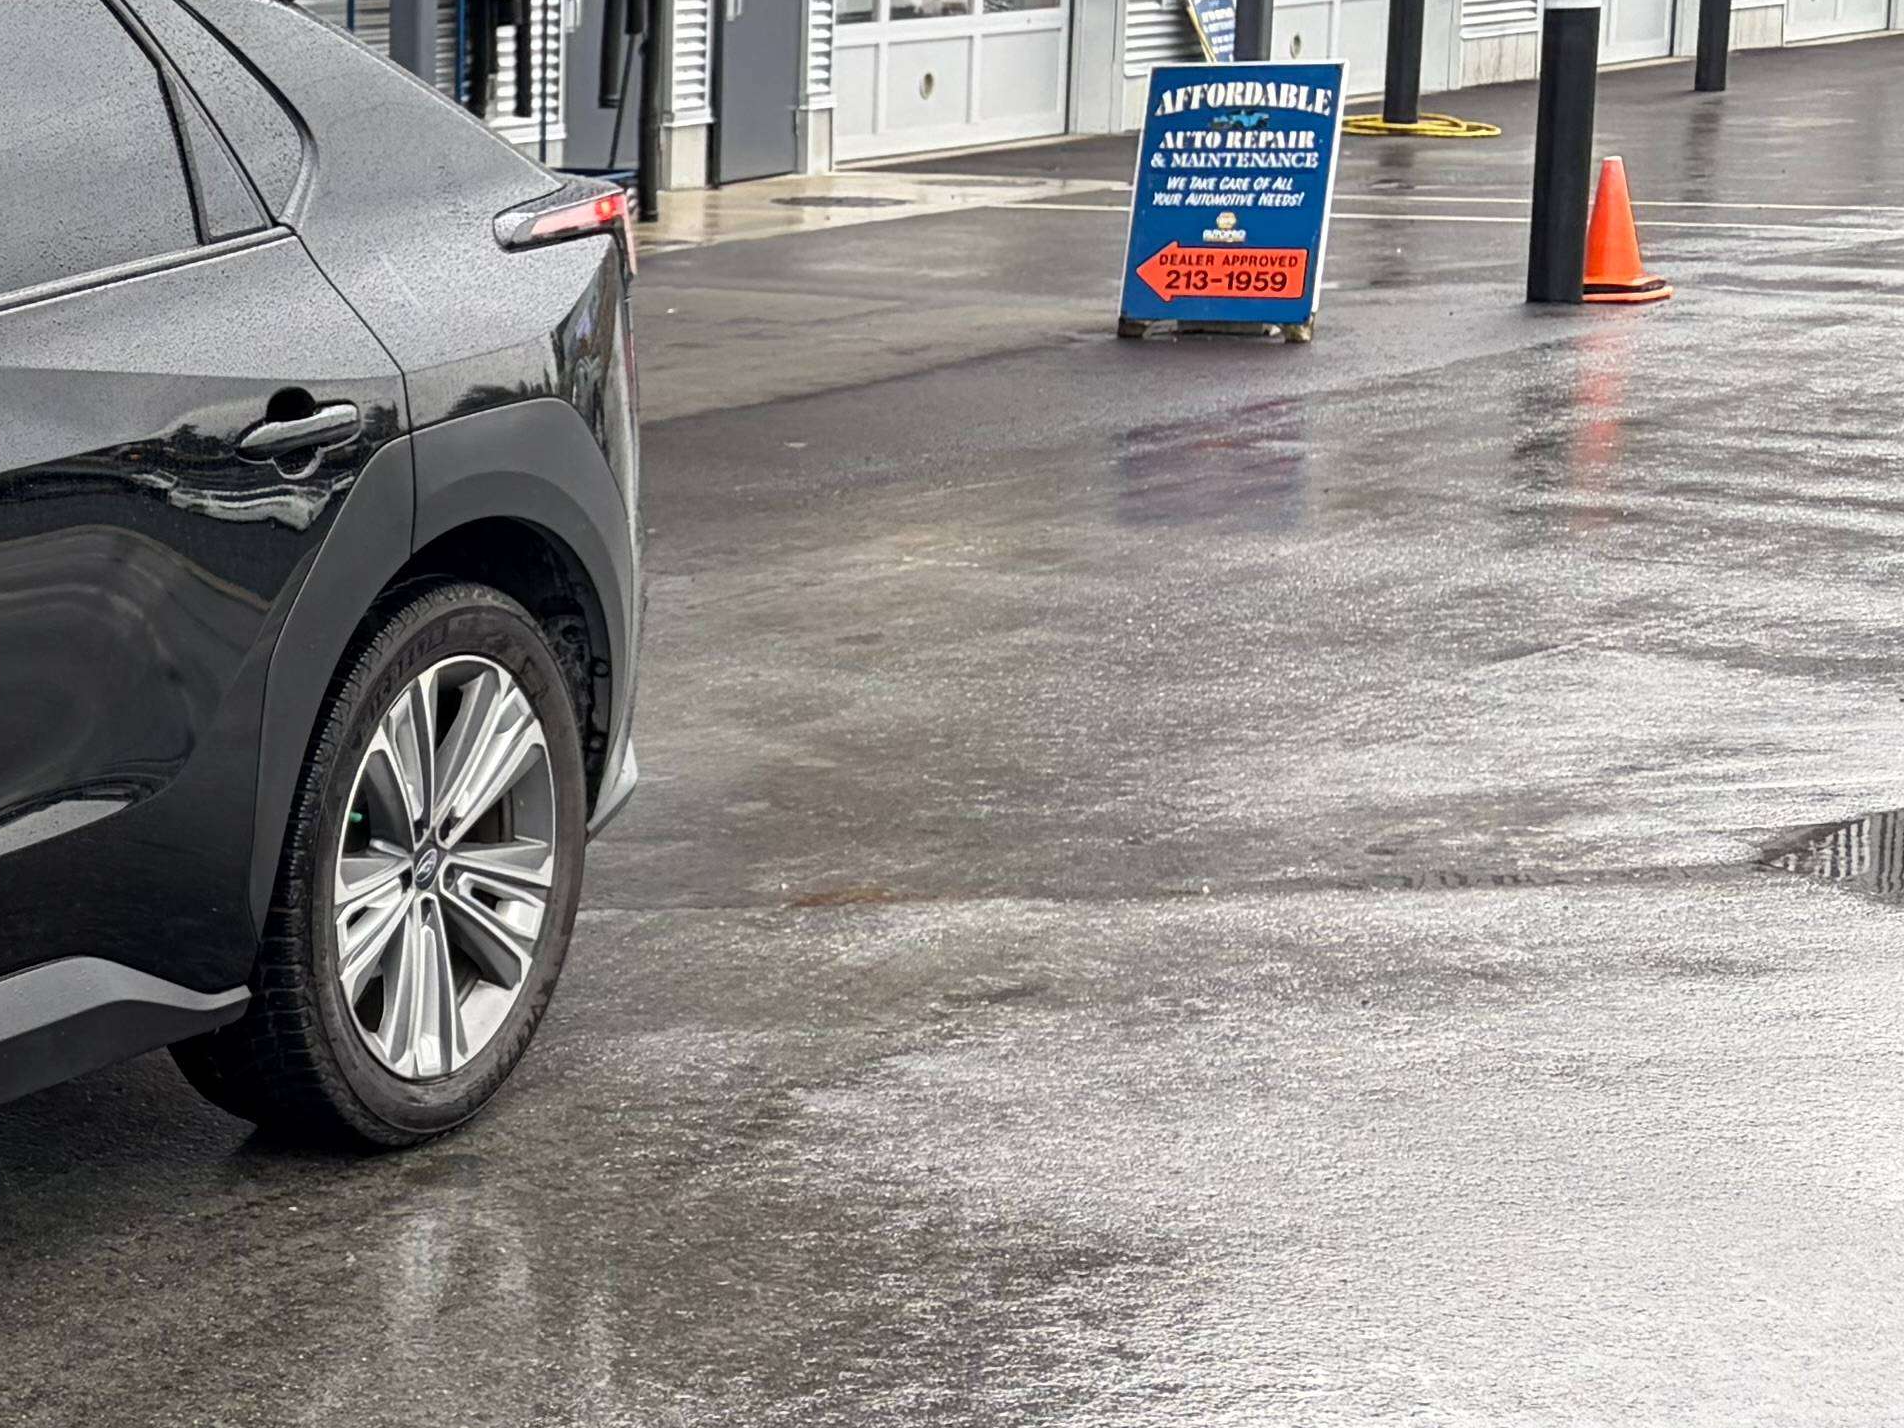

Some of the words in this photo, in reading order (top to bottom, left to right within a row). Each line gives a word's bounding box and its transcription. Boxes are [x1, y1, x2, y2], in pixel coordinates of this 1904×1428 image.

[1154, 81, 1332, 116] AFFORDABLE
[1159, 130, 1222, 149] AUTO
[1226, 130, 1316, 149] REPAIR
[1150, 151, 1166, 168] &
[1170, 151, 1319, 169] MAINTENANCE
[1167, 176, 1188, 191] WE
[1189, 176, 1218, 191] TAKE
[1219, 176, 1252, 191] CARE
[1253, 176, 1271, 191] OF
[1271, 176, 1294, 191] ALL
[1152, 192, 1182, 206] YOUR
[1185, 192, 1255, 206] AUTOMOTIVE
[1258, 191, 1305, 207] NEEDS!
[1159, 254, 1215, 266] DEALER
[1222, 254, 1299, 267] APPROVED
[1164, 269, 1288, 292] 213-1959
